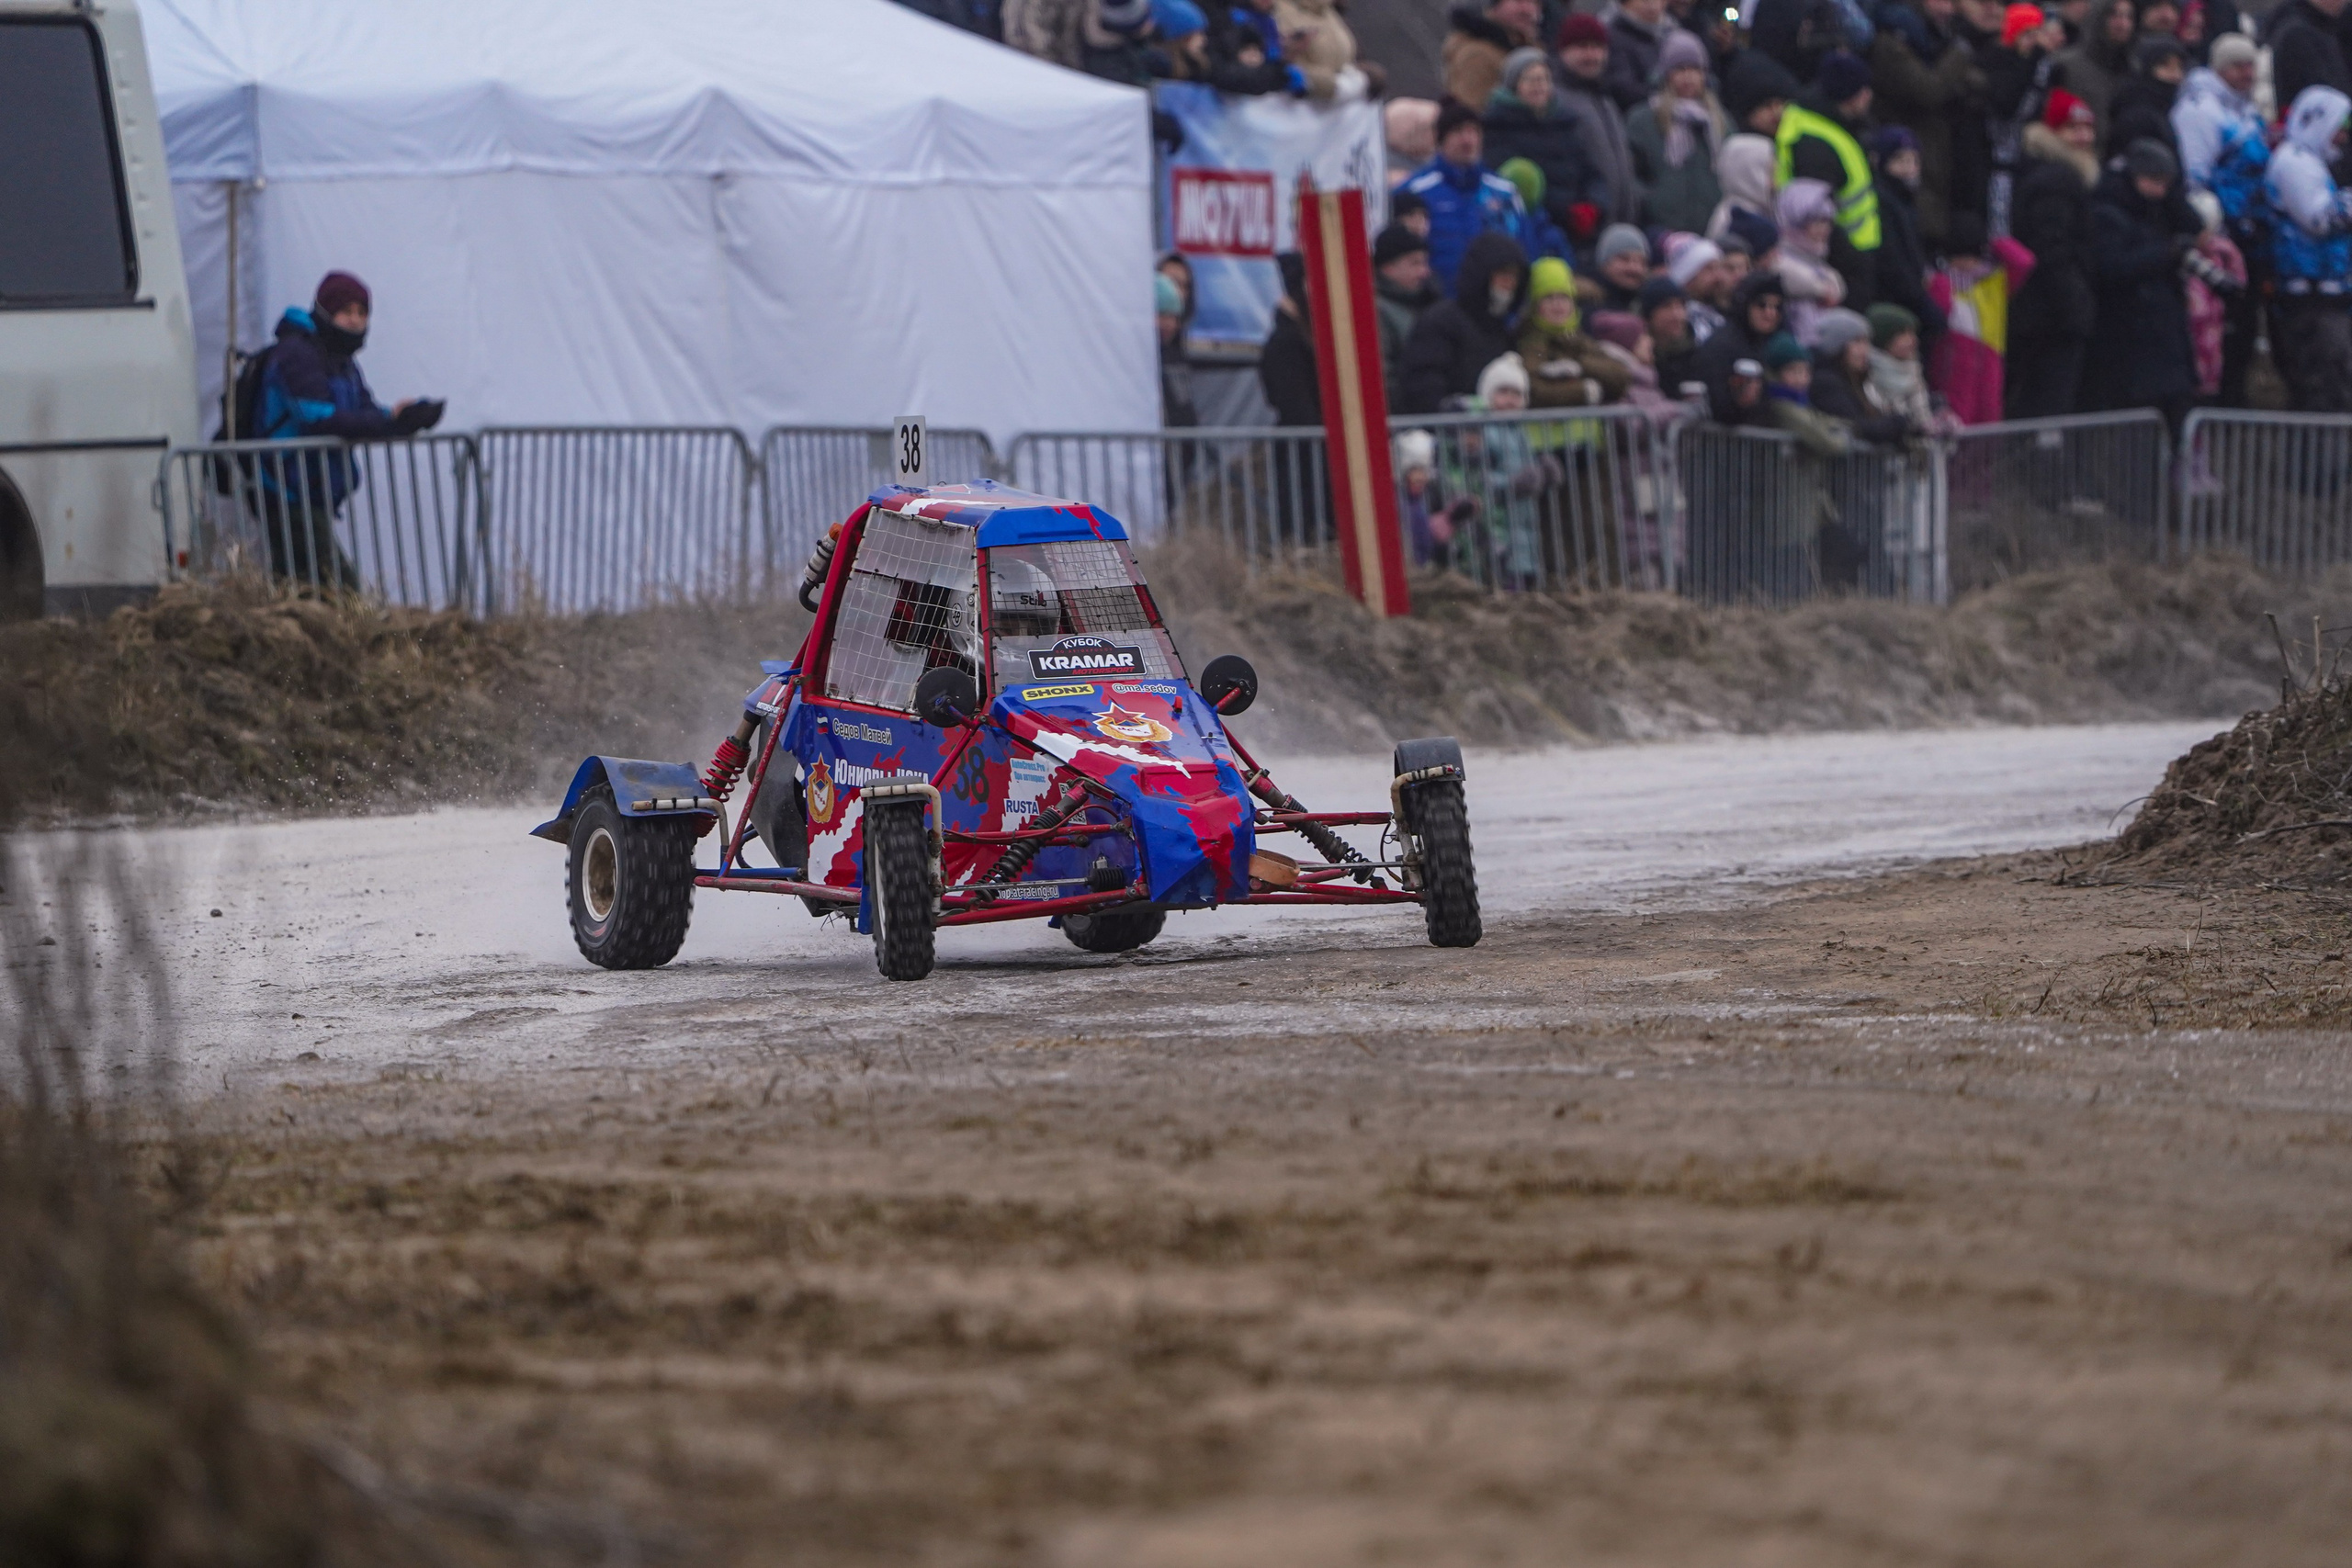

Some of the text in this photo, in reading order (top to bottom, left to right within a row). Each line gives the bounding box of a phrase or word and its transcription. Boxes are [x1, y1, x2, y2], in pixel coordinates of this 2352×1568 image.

[1178, 180, 1270, 246] MOTUL
[900, 424, 921, 474] 38
[1062, 637, 1102, 649] КУБОК
[1038, 653, 1135, 671] KRAMAR
[1071, 667, 1136, 675] MOTORSPORT
[1026, 685, 1093, 698] SHONX
[1113, 683, 1177, 694] @ma.sedov
[832, 718, 892, 745] Седов Матвей
[950, 744, 989, 803] 38
[1005, 799, 1039, 815] RUSTA
